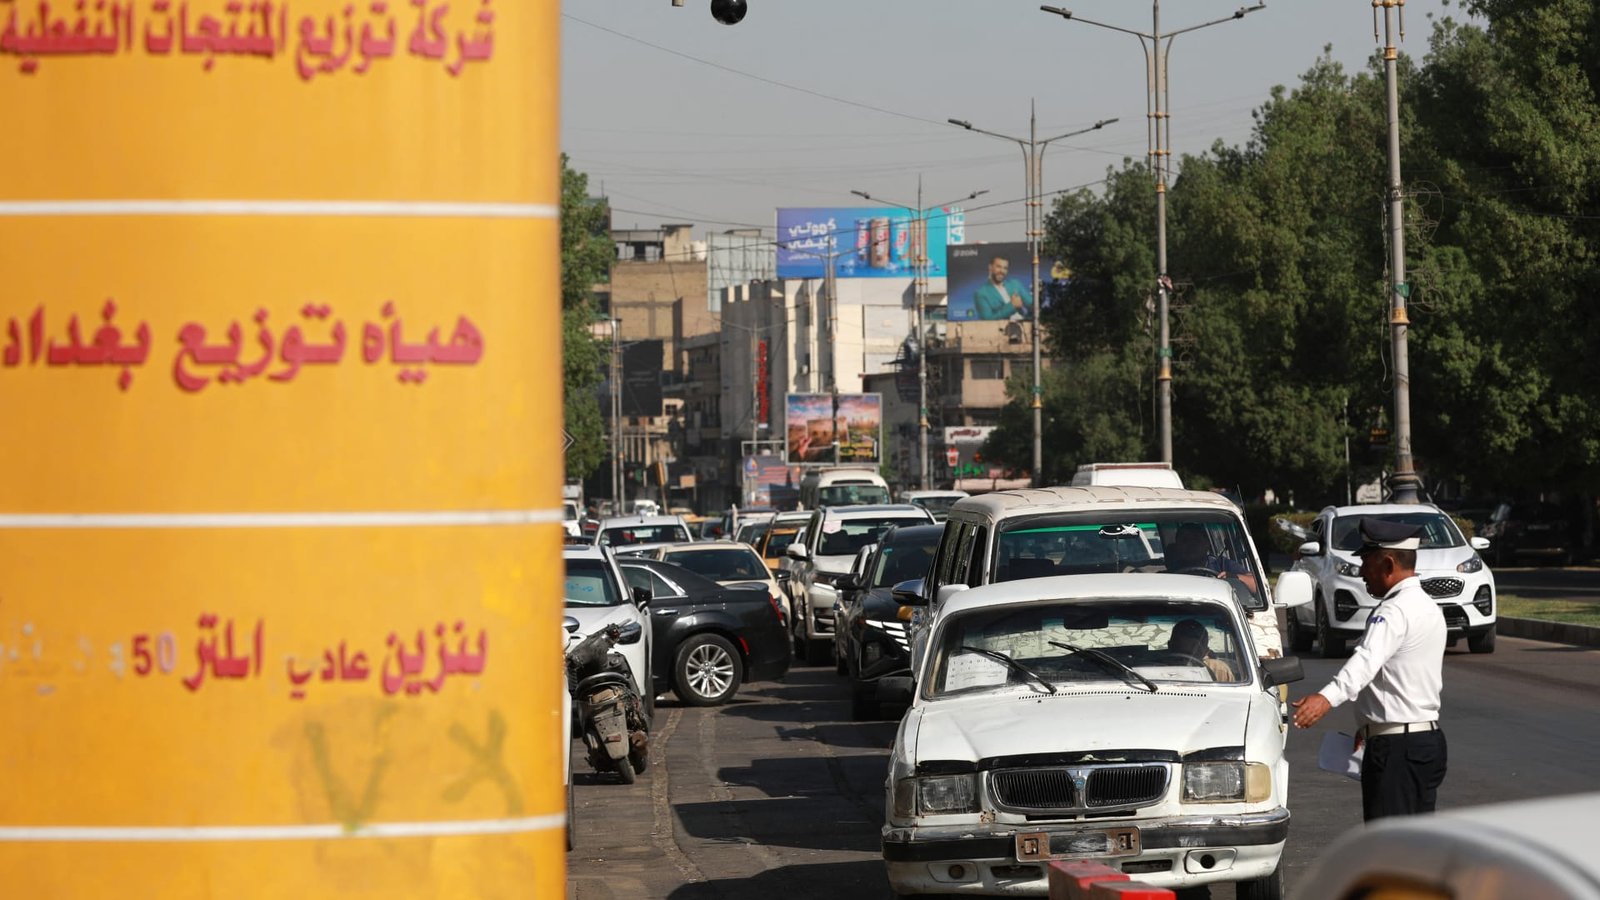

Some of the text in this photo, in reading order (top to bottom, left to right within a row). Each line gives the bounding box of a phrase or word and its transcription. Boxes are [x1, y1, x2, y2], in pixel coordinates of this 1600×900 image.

[295, 2, 398, 83] توزيع
[408, 0, 496, 77] شركة
[3, 298, 154, 392] بغداد
[171, 303, 348, 395] توزيع
[285, 640, 372, 700] عادي
[380, 619, 489, 697] بنزين
